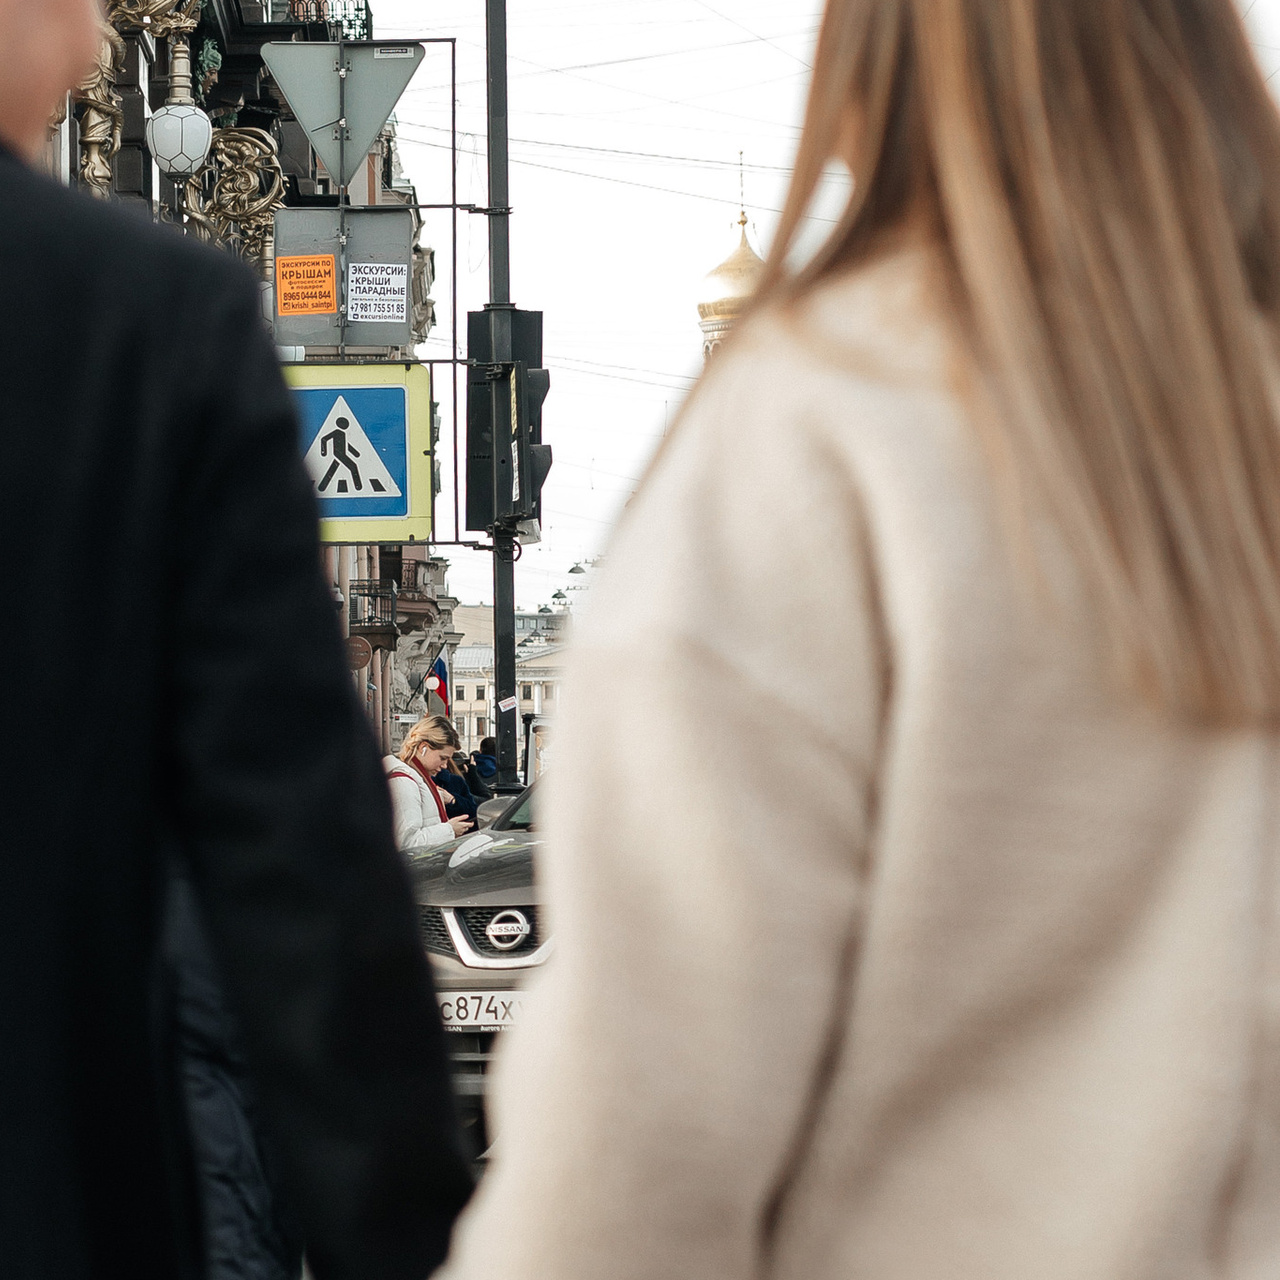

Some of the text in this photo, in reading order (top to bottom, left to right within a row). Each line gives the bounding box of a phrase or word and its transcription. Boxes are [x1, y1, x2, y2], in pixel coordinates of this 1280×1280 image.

[281, 261, 320, 269] ЭКСКУРСИИ
[281, 269, 332, 280] КРЫШАМ
[351, 265, 406, 276] ЭКСКУРСИИ:
[355, 276, 391, 285] КРЫШИ
[355, 286, 406, 296] ПАРАДНЫЕ
[350, 303, 405, 313] +7 981 755 51 85
